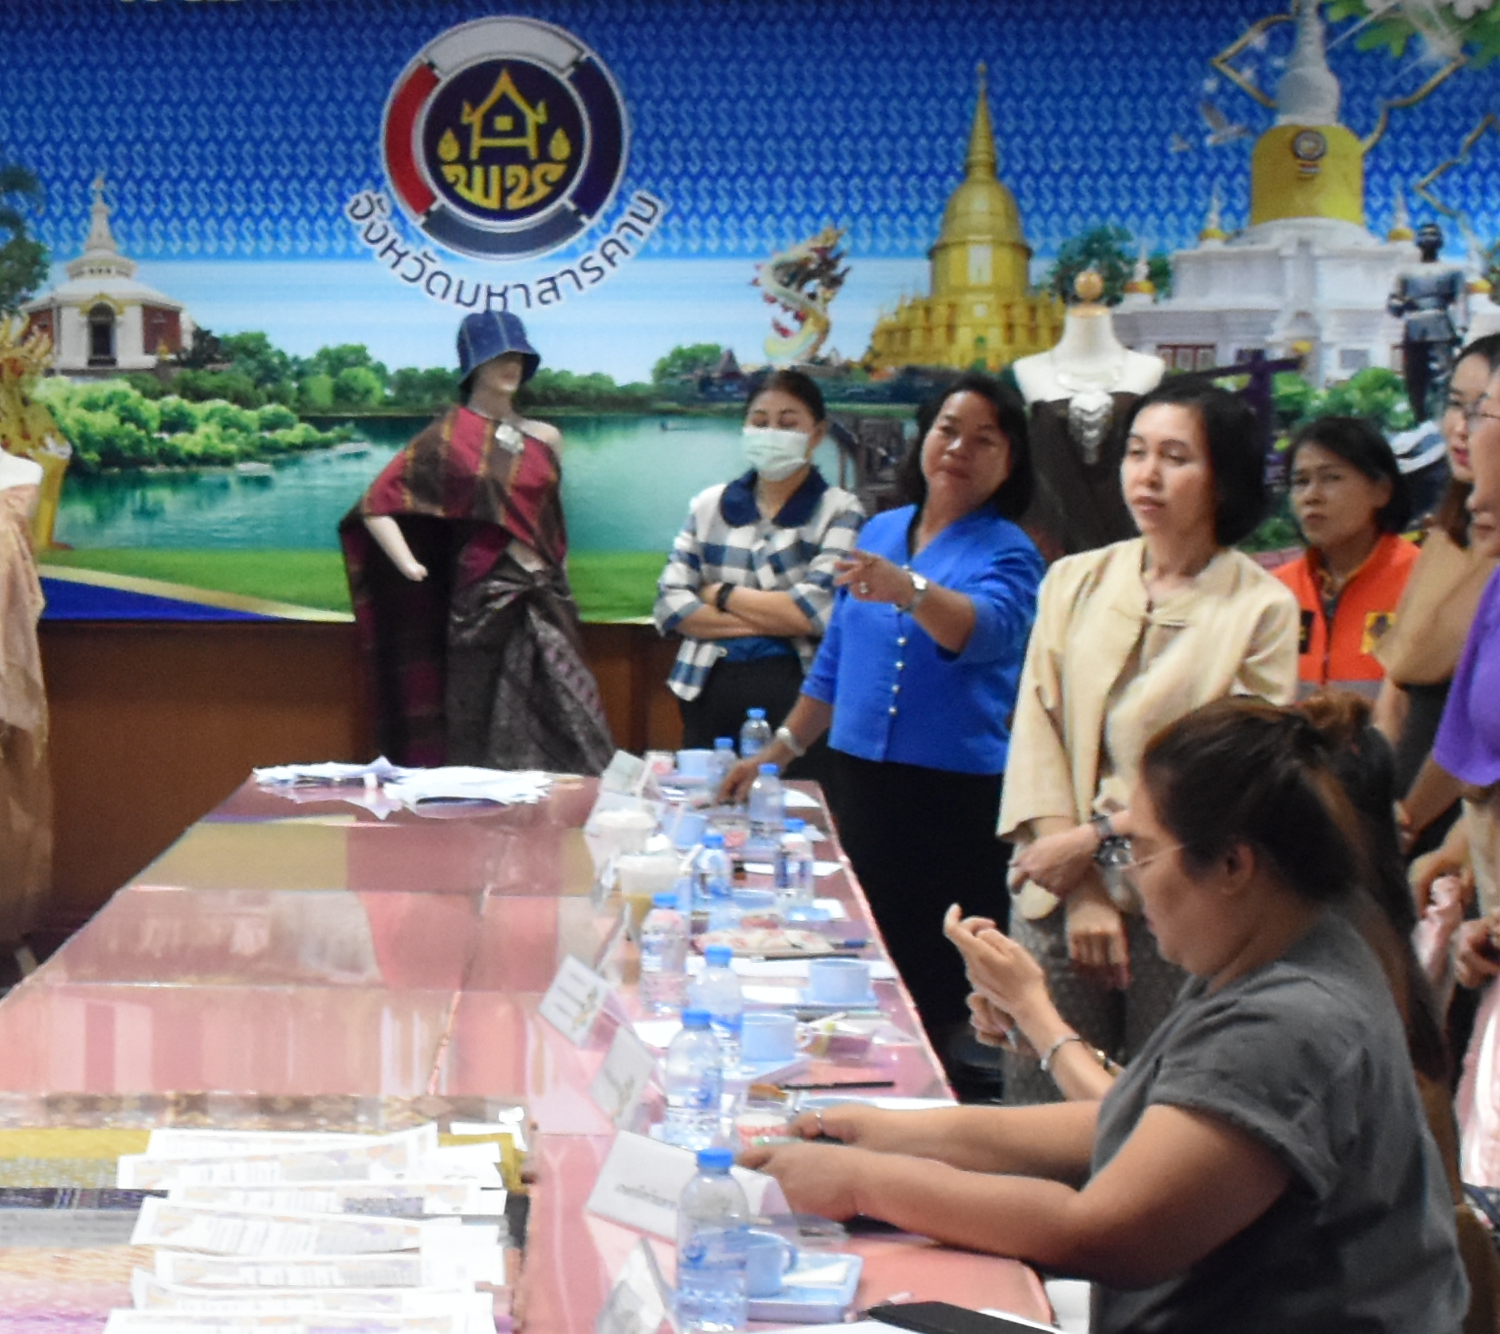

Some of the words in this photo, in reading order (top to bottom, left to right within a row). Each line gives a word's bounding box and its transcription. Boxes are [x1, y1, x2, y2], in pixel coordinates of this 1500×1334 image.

[348, 192, 663, 310] จังหวัดมหาสารคาม
